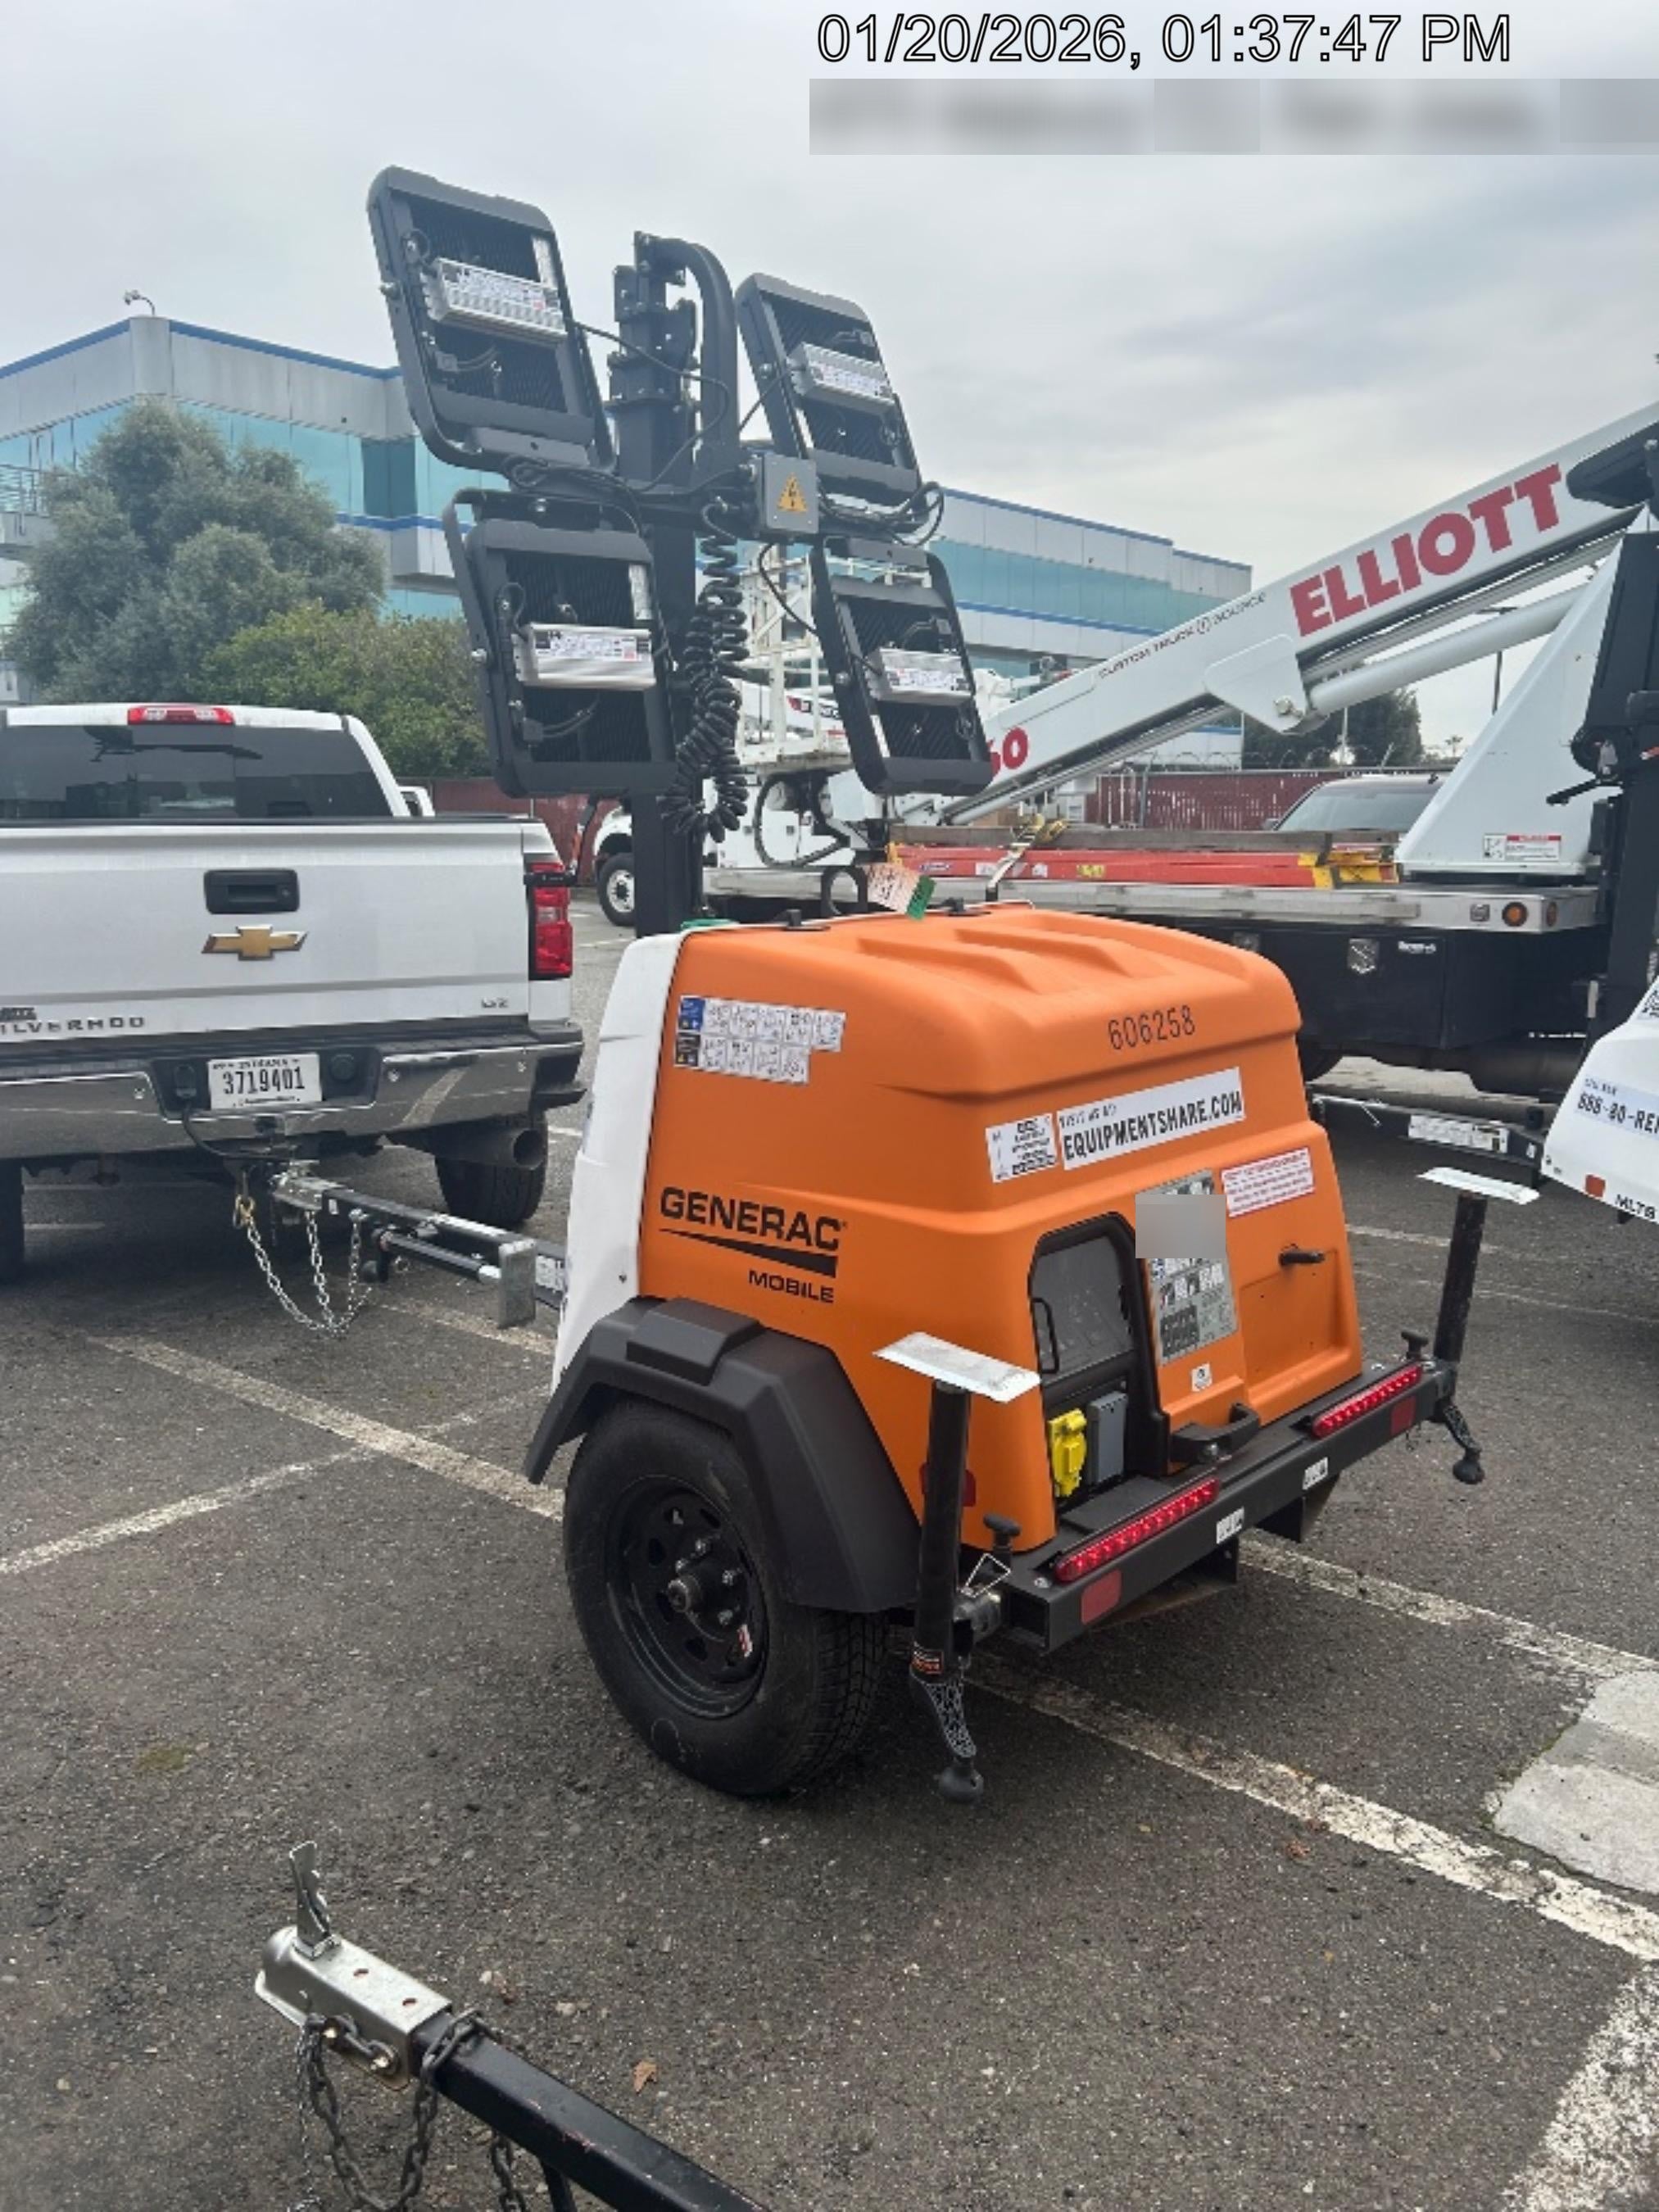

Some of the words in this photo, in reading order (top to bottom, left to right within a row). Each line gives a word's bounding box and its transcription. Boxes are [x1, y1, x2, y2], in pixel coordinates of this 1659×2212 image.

[1290, 462, 1562, 637] ELLIOTT
[1108, 1004, 1195, 1050] 606258
[223, 1066, 306, 1095] 3719401
[1063, 1090, 1243, 1161] EQUIPMENTSHARE.COM
[660, 1186, 840, 1252] GENERAC
[748, 1269, 834, 1304] MOBILE
